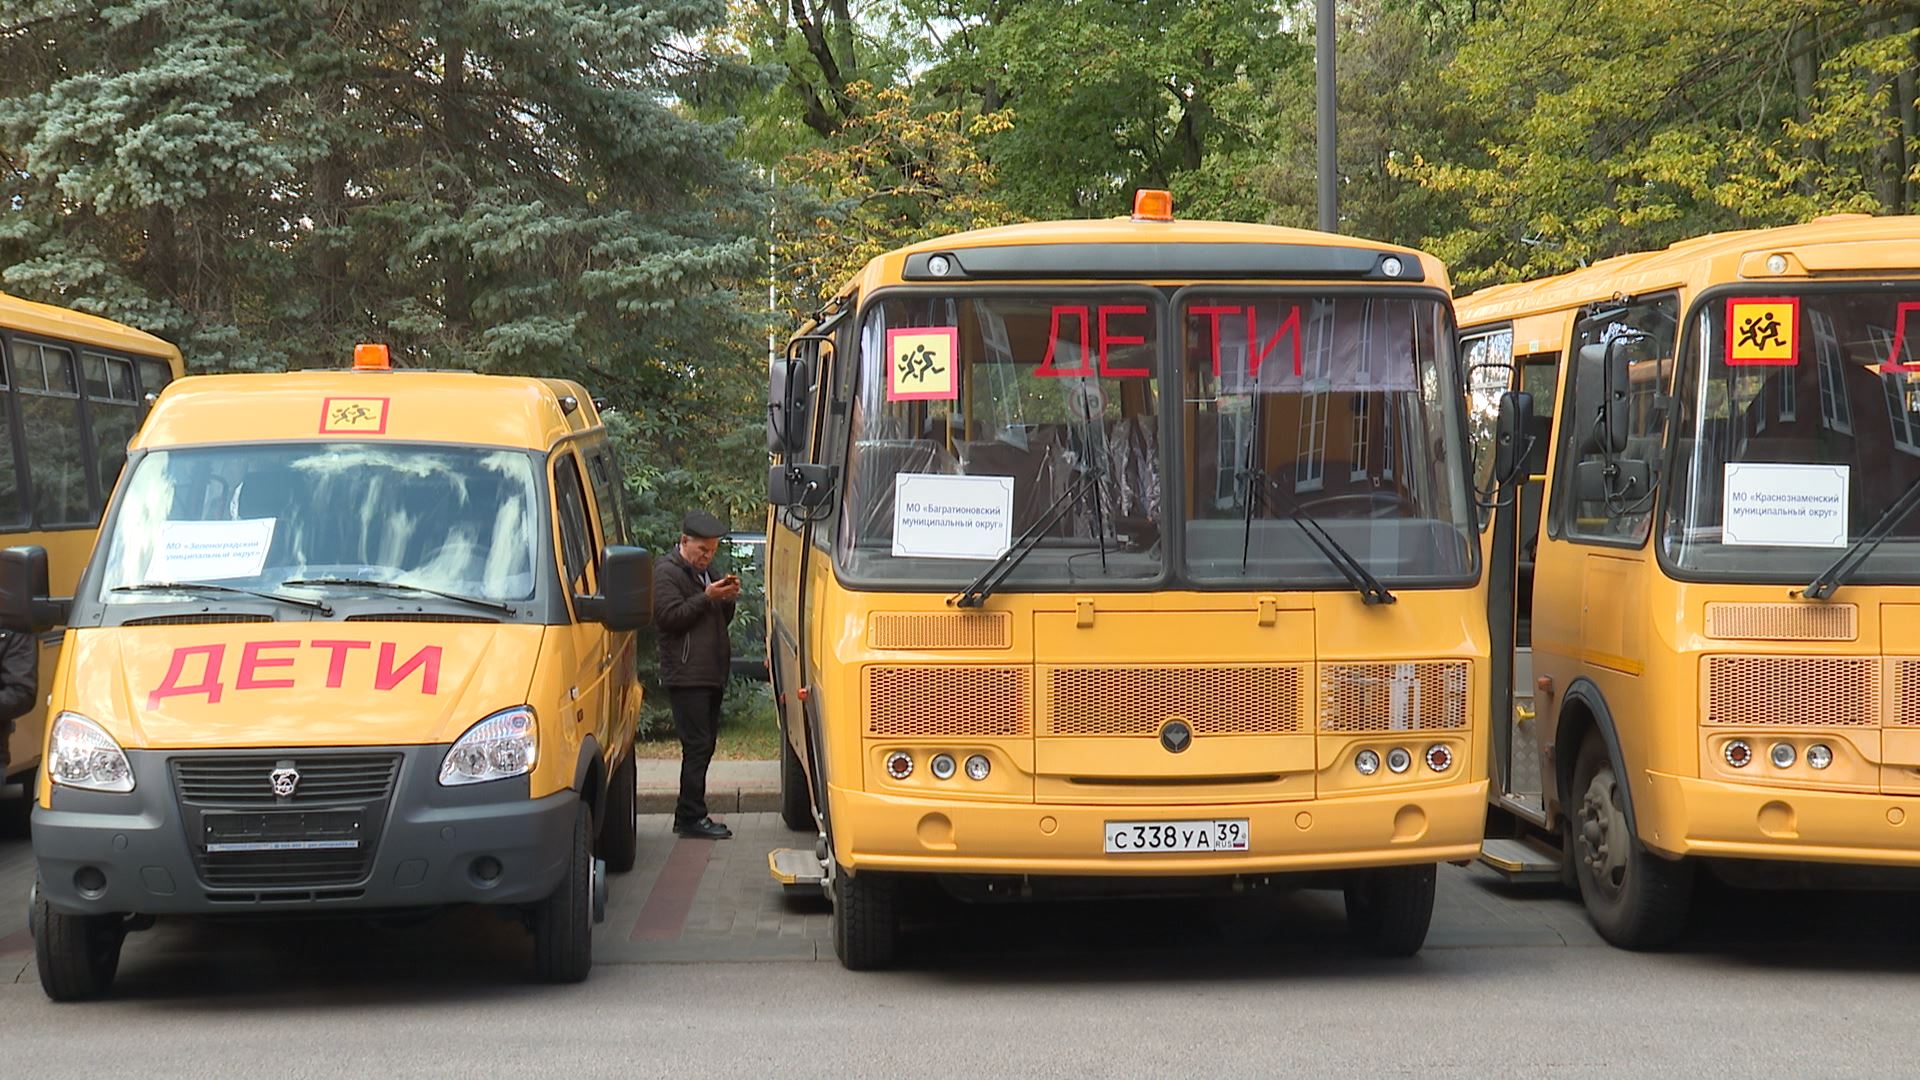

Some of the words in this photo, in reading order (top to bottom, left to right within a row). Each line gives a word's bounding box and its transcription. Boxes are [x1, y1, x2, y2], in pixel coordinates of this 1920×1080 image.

[1732, 492, 1747, 501] МО
[1750, 492, 1839, 503] «Краснознаменский
[906, 503, 921, 512] МО
[923, 503, 1001, 515] «Багратионовский
[1733, 507, 1806, 516] муниципальный
[1809, 508, 1838, 518] округ»
[902, 517, 973, 528] муниципальный
[975, 519, 1003, 530] округ»
[146, 639, 443, 712] ДЕТИ
[1217, 823, 1240, 841] 39
